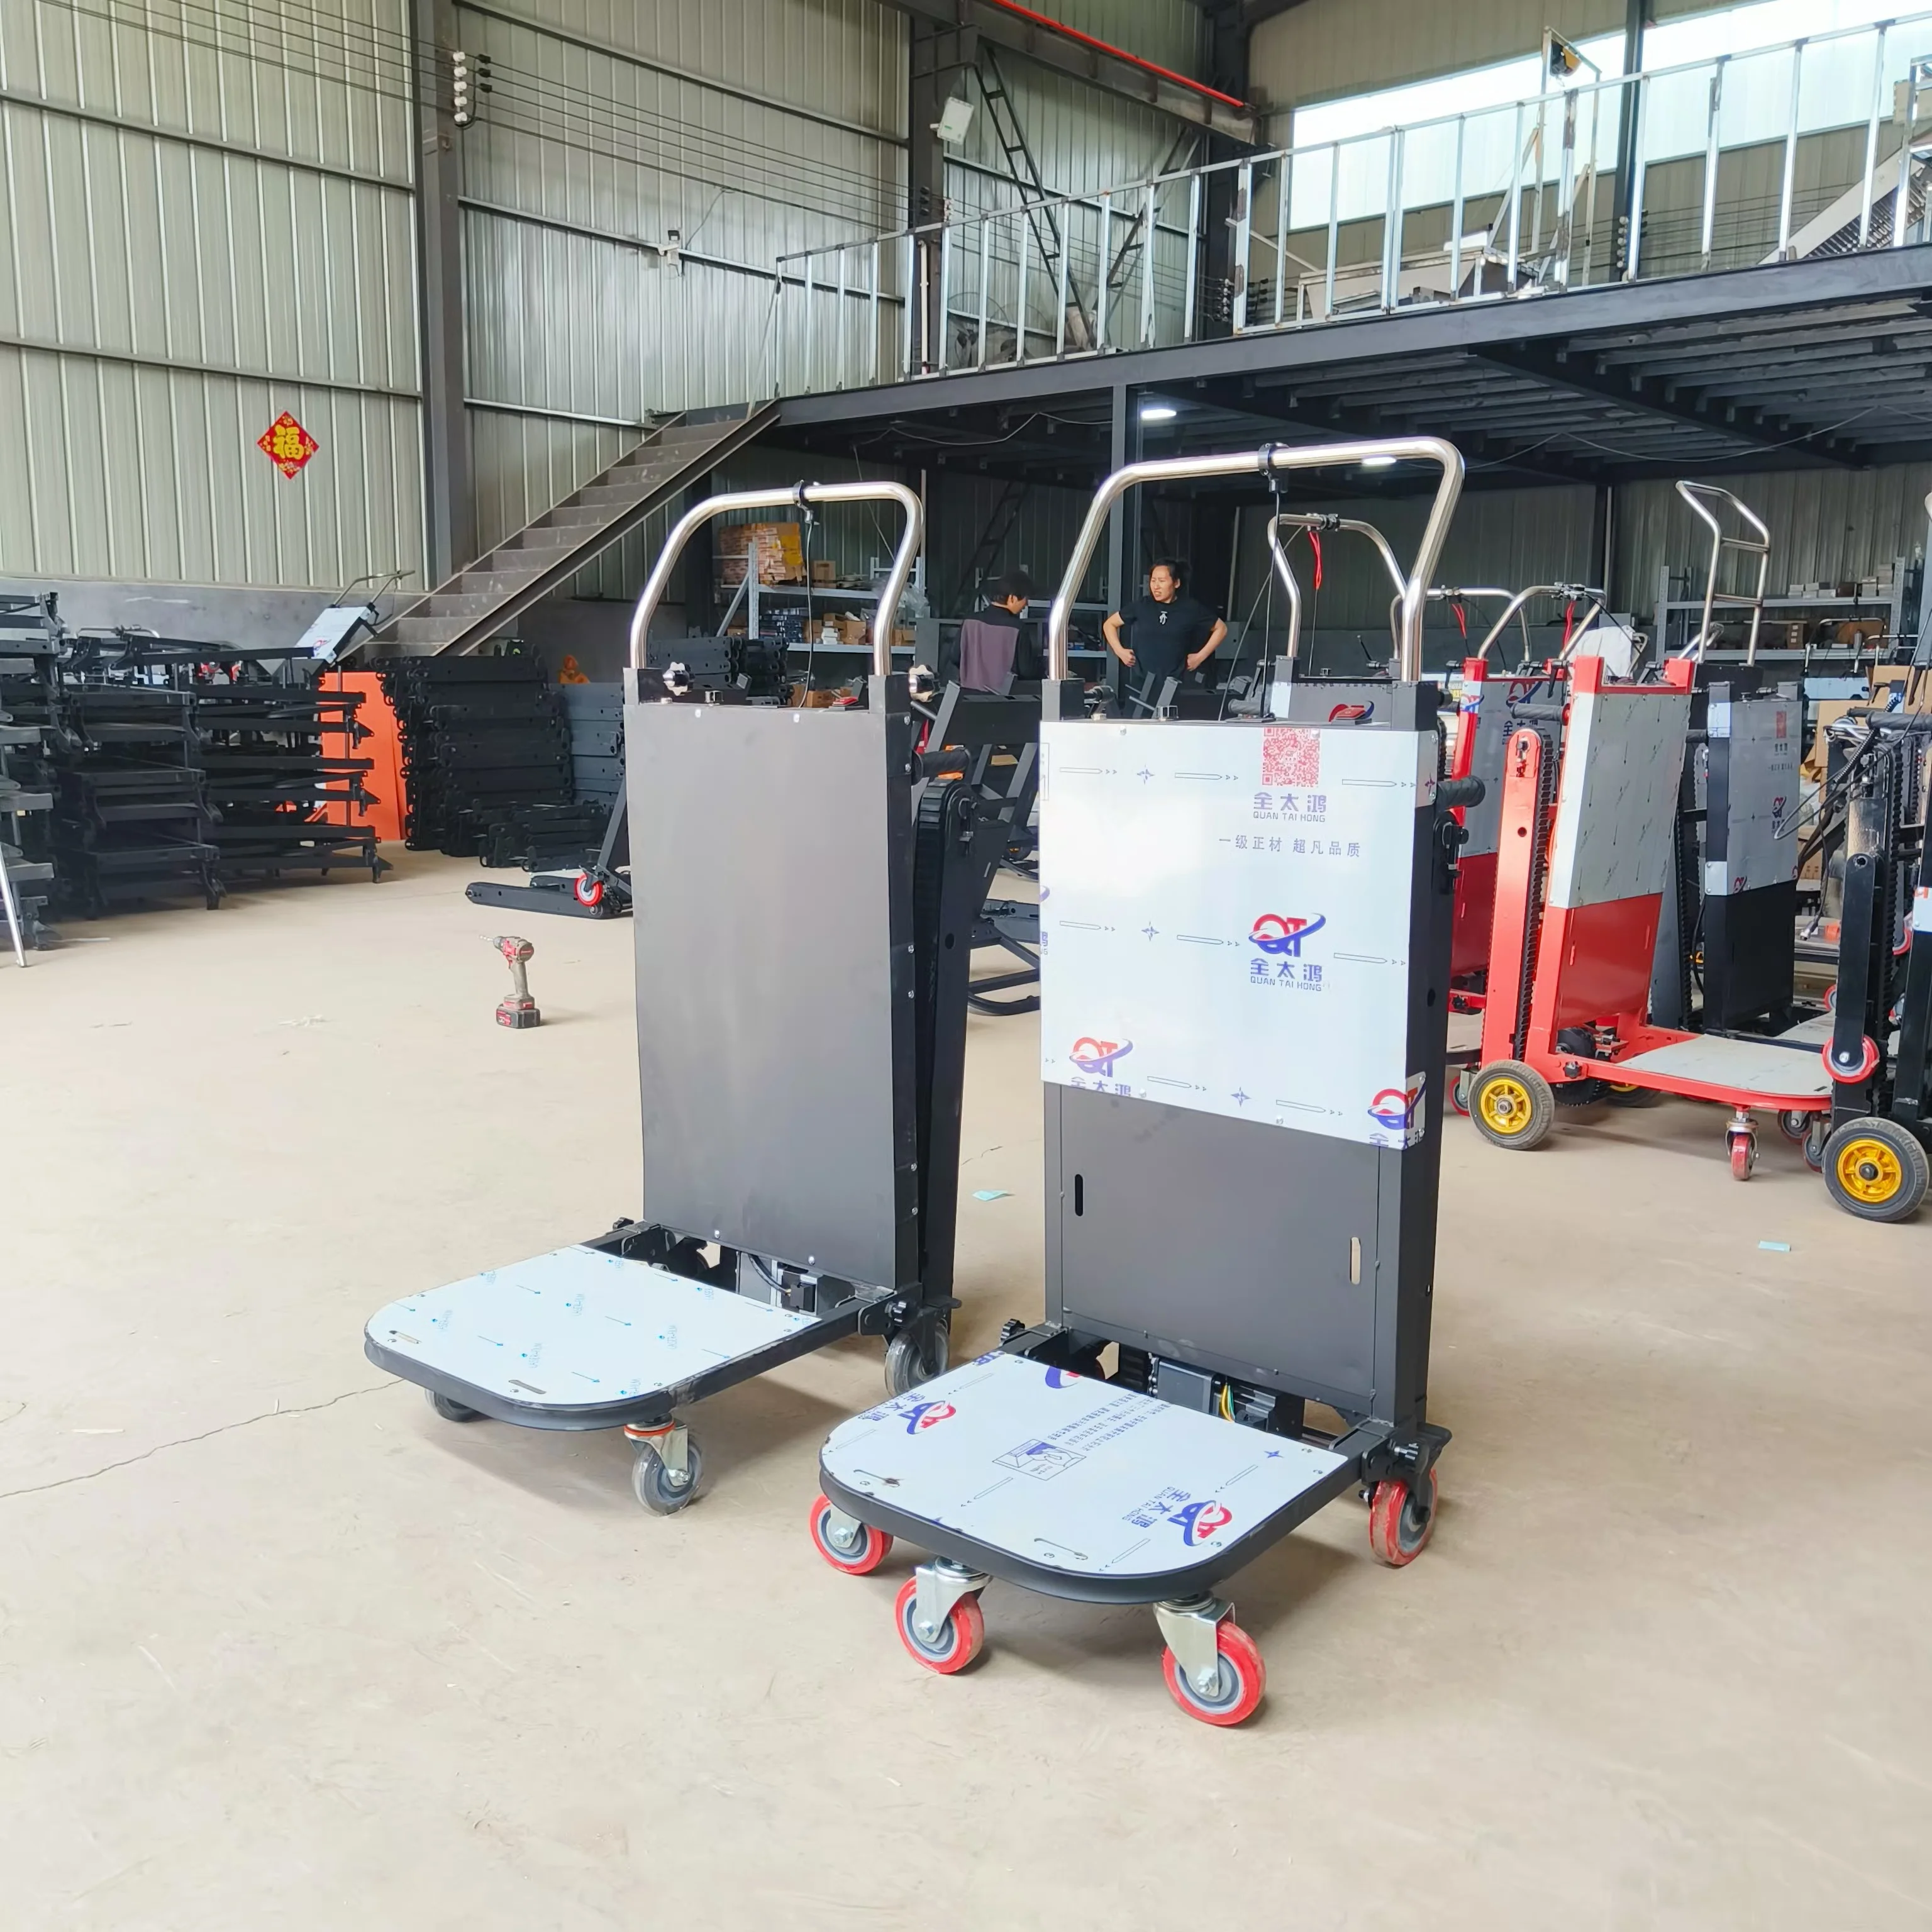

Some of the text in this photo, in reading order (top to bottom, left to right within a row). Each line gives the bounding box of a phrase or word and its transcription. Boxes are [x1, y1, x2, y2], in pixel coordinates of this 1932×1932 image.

[1253, 792, 1327, 813] 全太鸿
[1253, 811, 1325, 823] QUAN TAI HONG
[1219, 835, 1360, 857] 一级正材 超凡品质
[1250, 958, 1322, 982] 全太鸿
[1250, 975, 1322, 992] QUAN TAI HONG
[1131, 1489, 1191, 1528] 全太鸿
